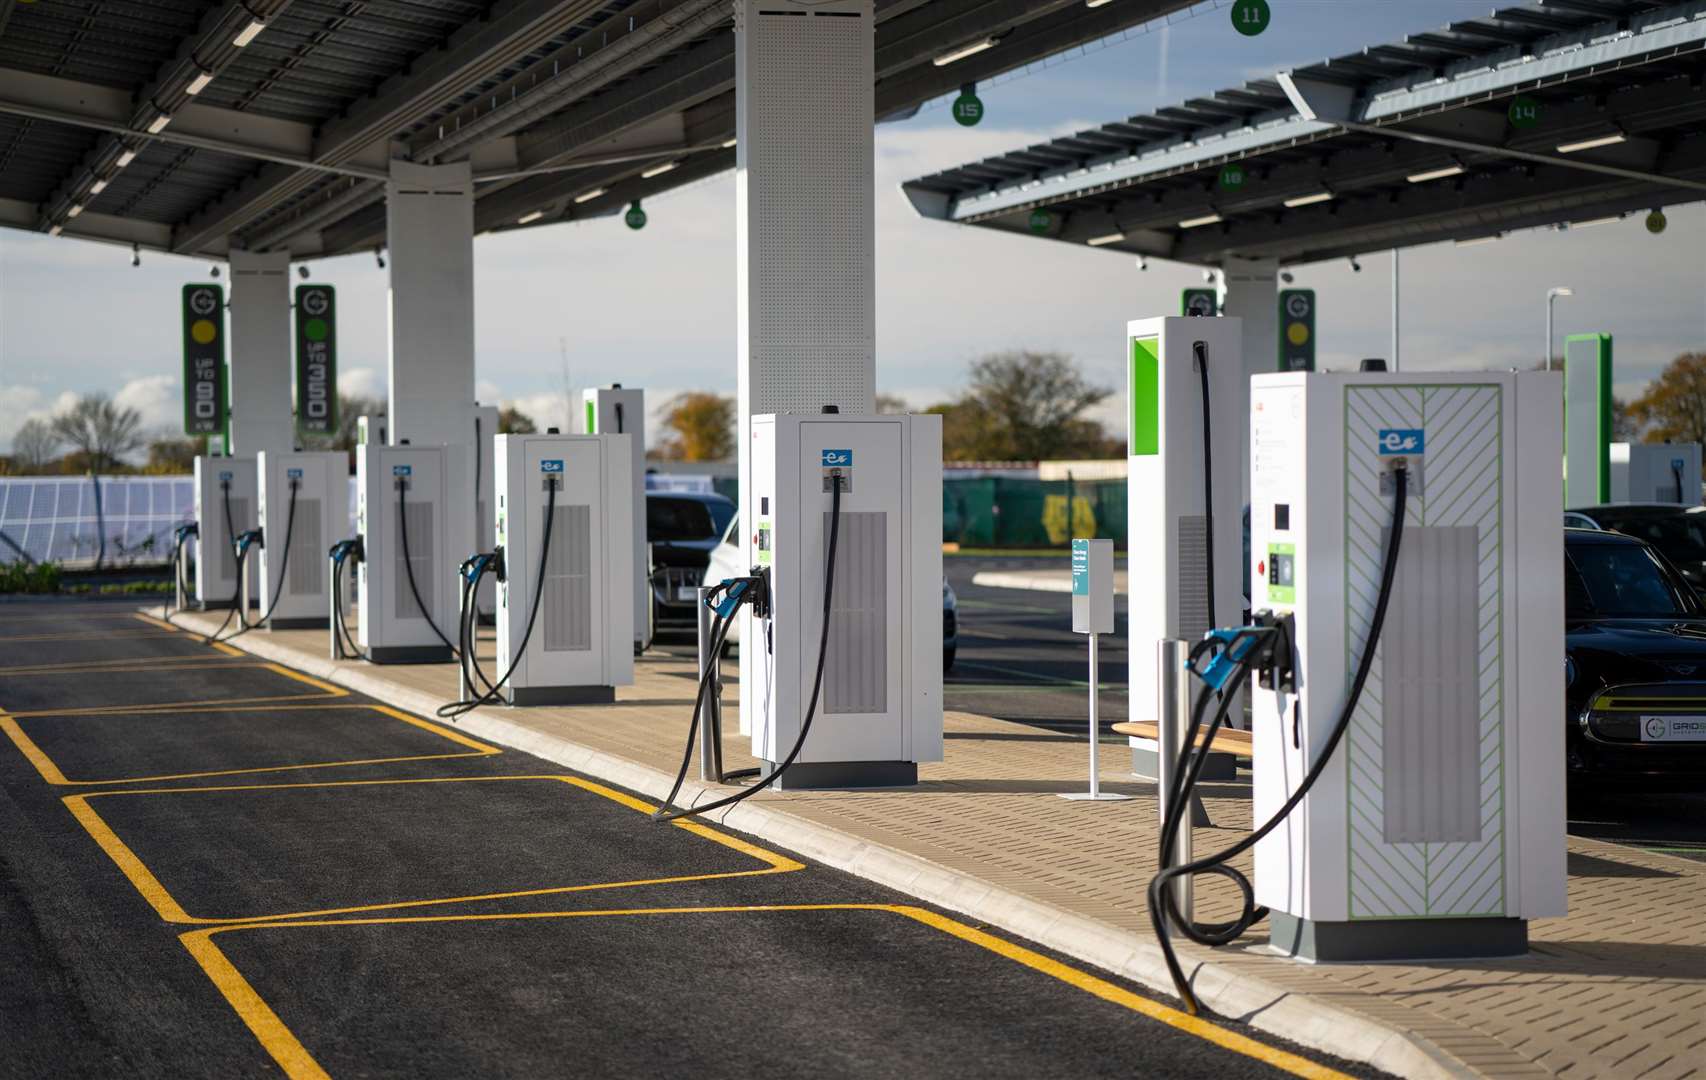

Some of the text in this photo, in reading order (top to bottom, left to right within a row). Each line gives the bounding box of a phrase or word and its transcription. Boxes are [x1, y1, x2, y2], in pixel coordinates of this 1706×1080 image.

[1242, 6, 1261, 24] 11
[958, 103, 980, 118] 15
[1515, 106, 1536, 120] 14
[306, 342, 326, 352] UP
[195, 358, 214, 368] UP
[307, 352, 327, 362] TO
[196, 369, 215, 380] TO
[308, 364, 327, 417] 350
[195, 381, 216, 418] 90
